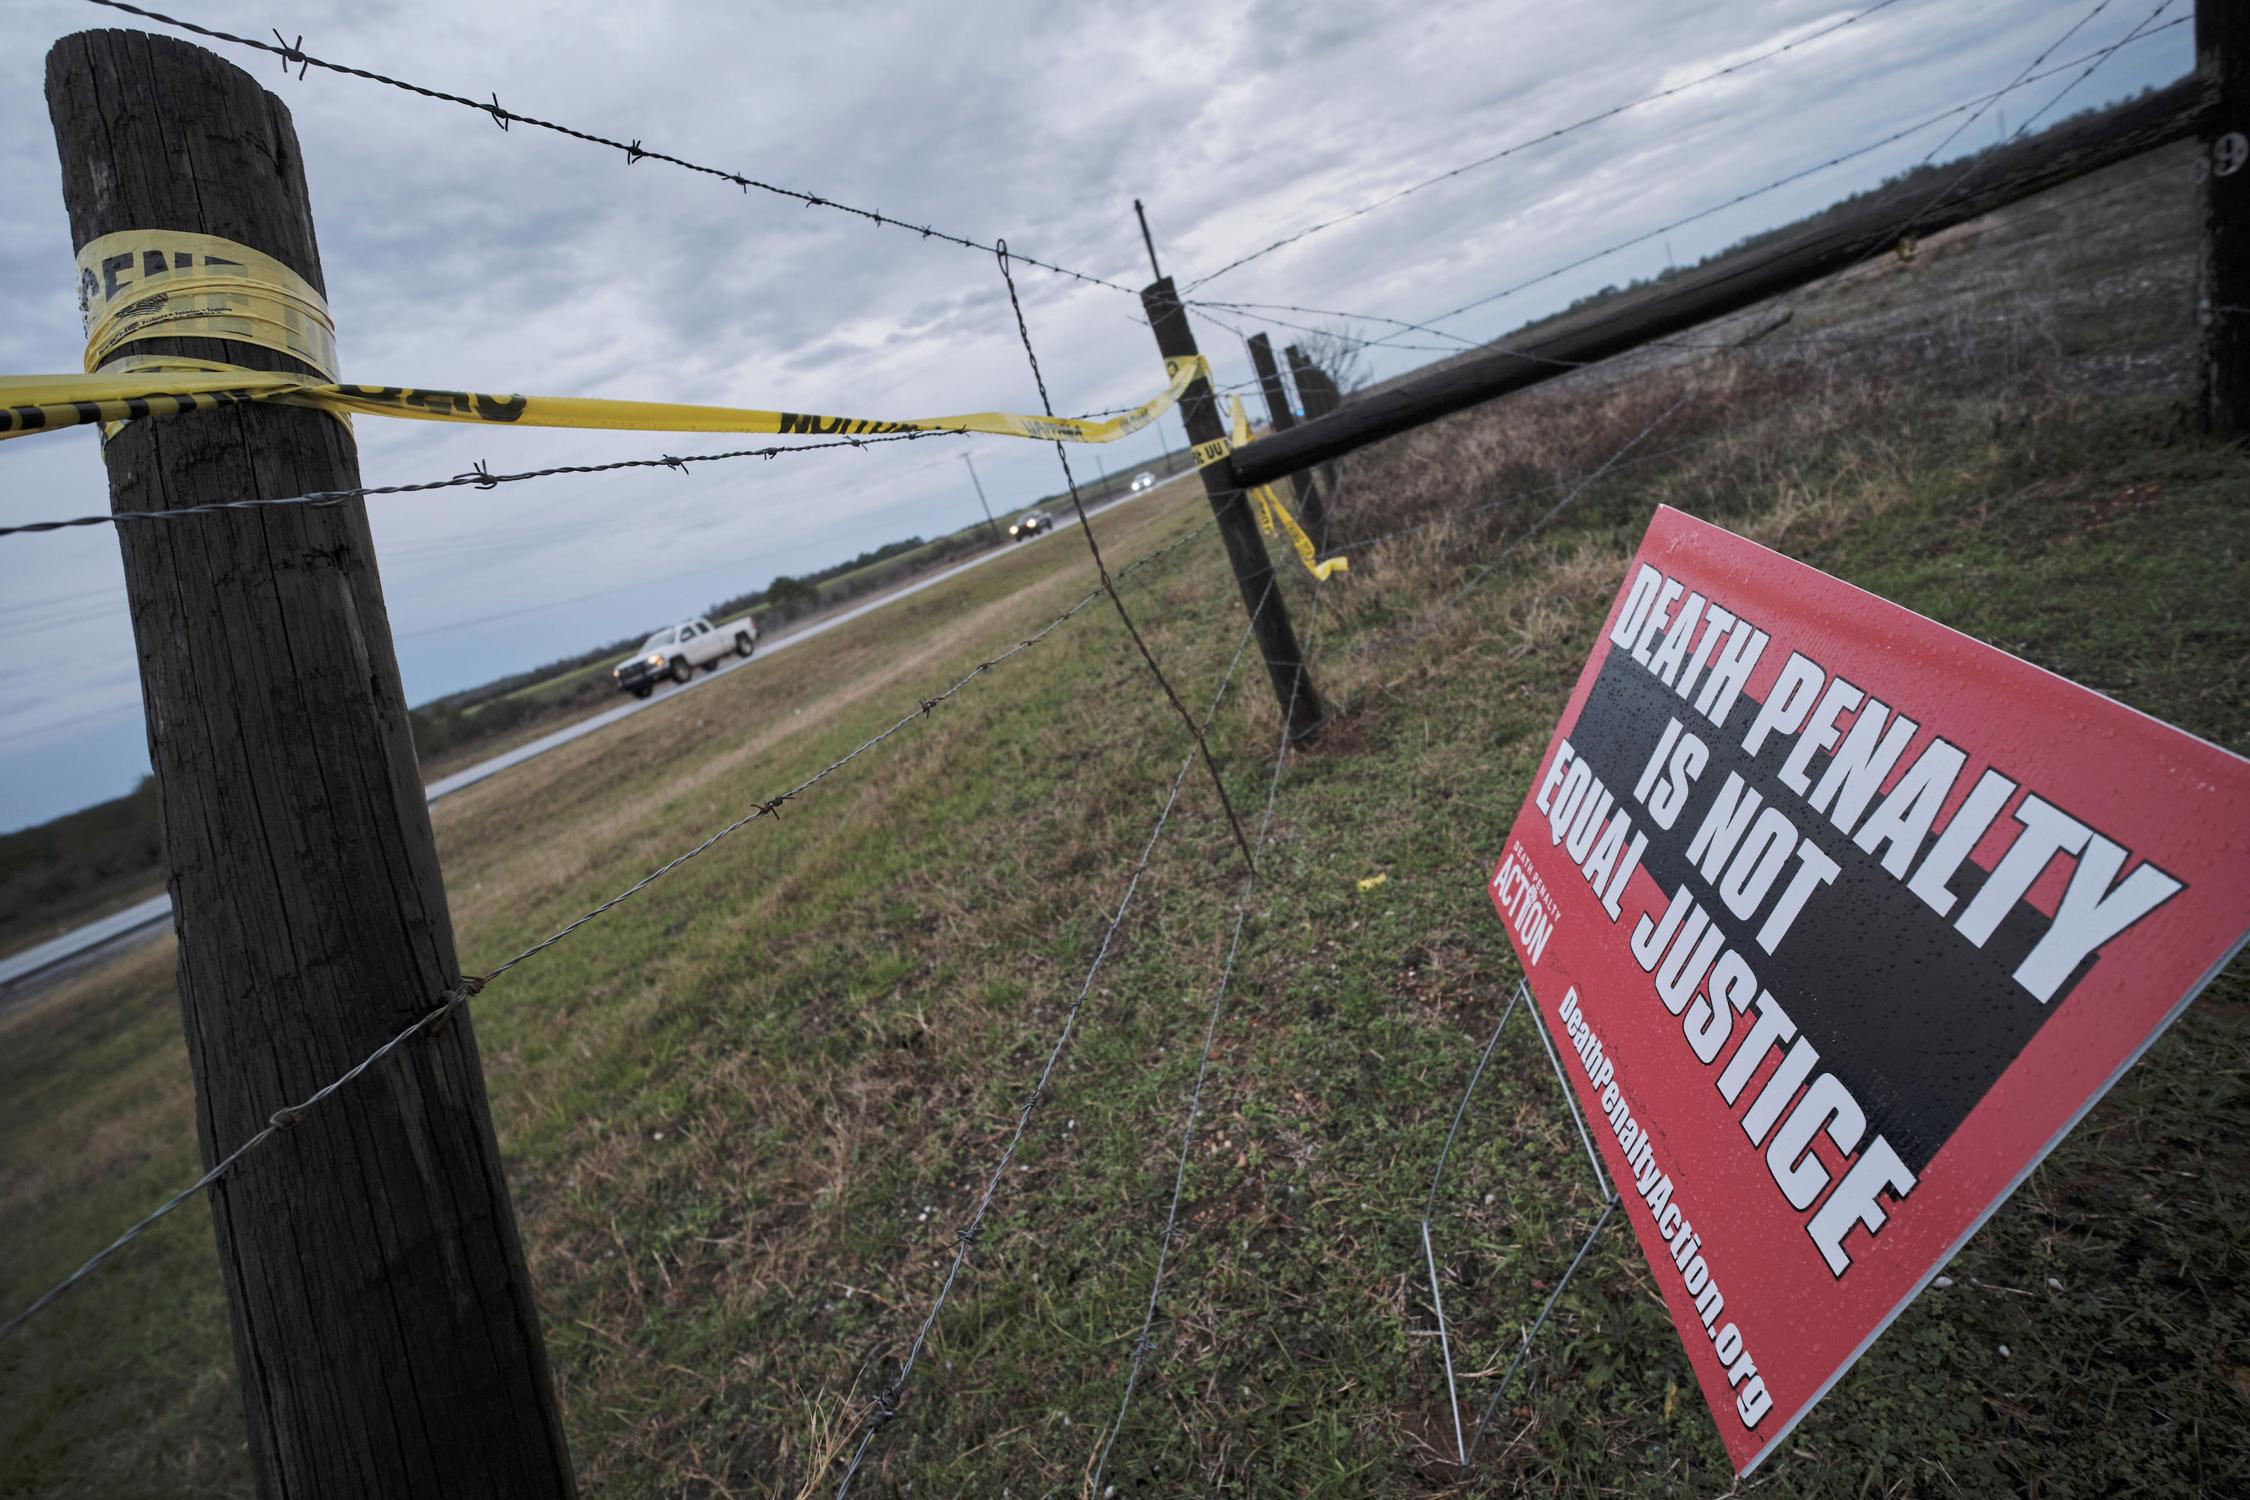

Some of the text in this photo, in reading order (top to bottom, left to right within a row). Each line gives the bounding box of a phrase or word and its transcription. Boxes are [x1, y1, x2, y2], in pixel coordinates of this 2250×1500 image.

[1493, 853, 1553, 967] ACTION
[1513, 840, 1561, 922] DEATH PENALTY
[1609, 563, 2189, 1004] DEATH PENALTY
[1632, 716, 1842, 957] IS NOT
[1535, 738, 1920, 1280] EQUAL JUSTICE
[1558, 985, 1774, 1431] DeathPenaltyAction.org
